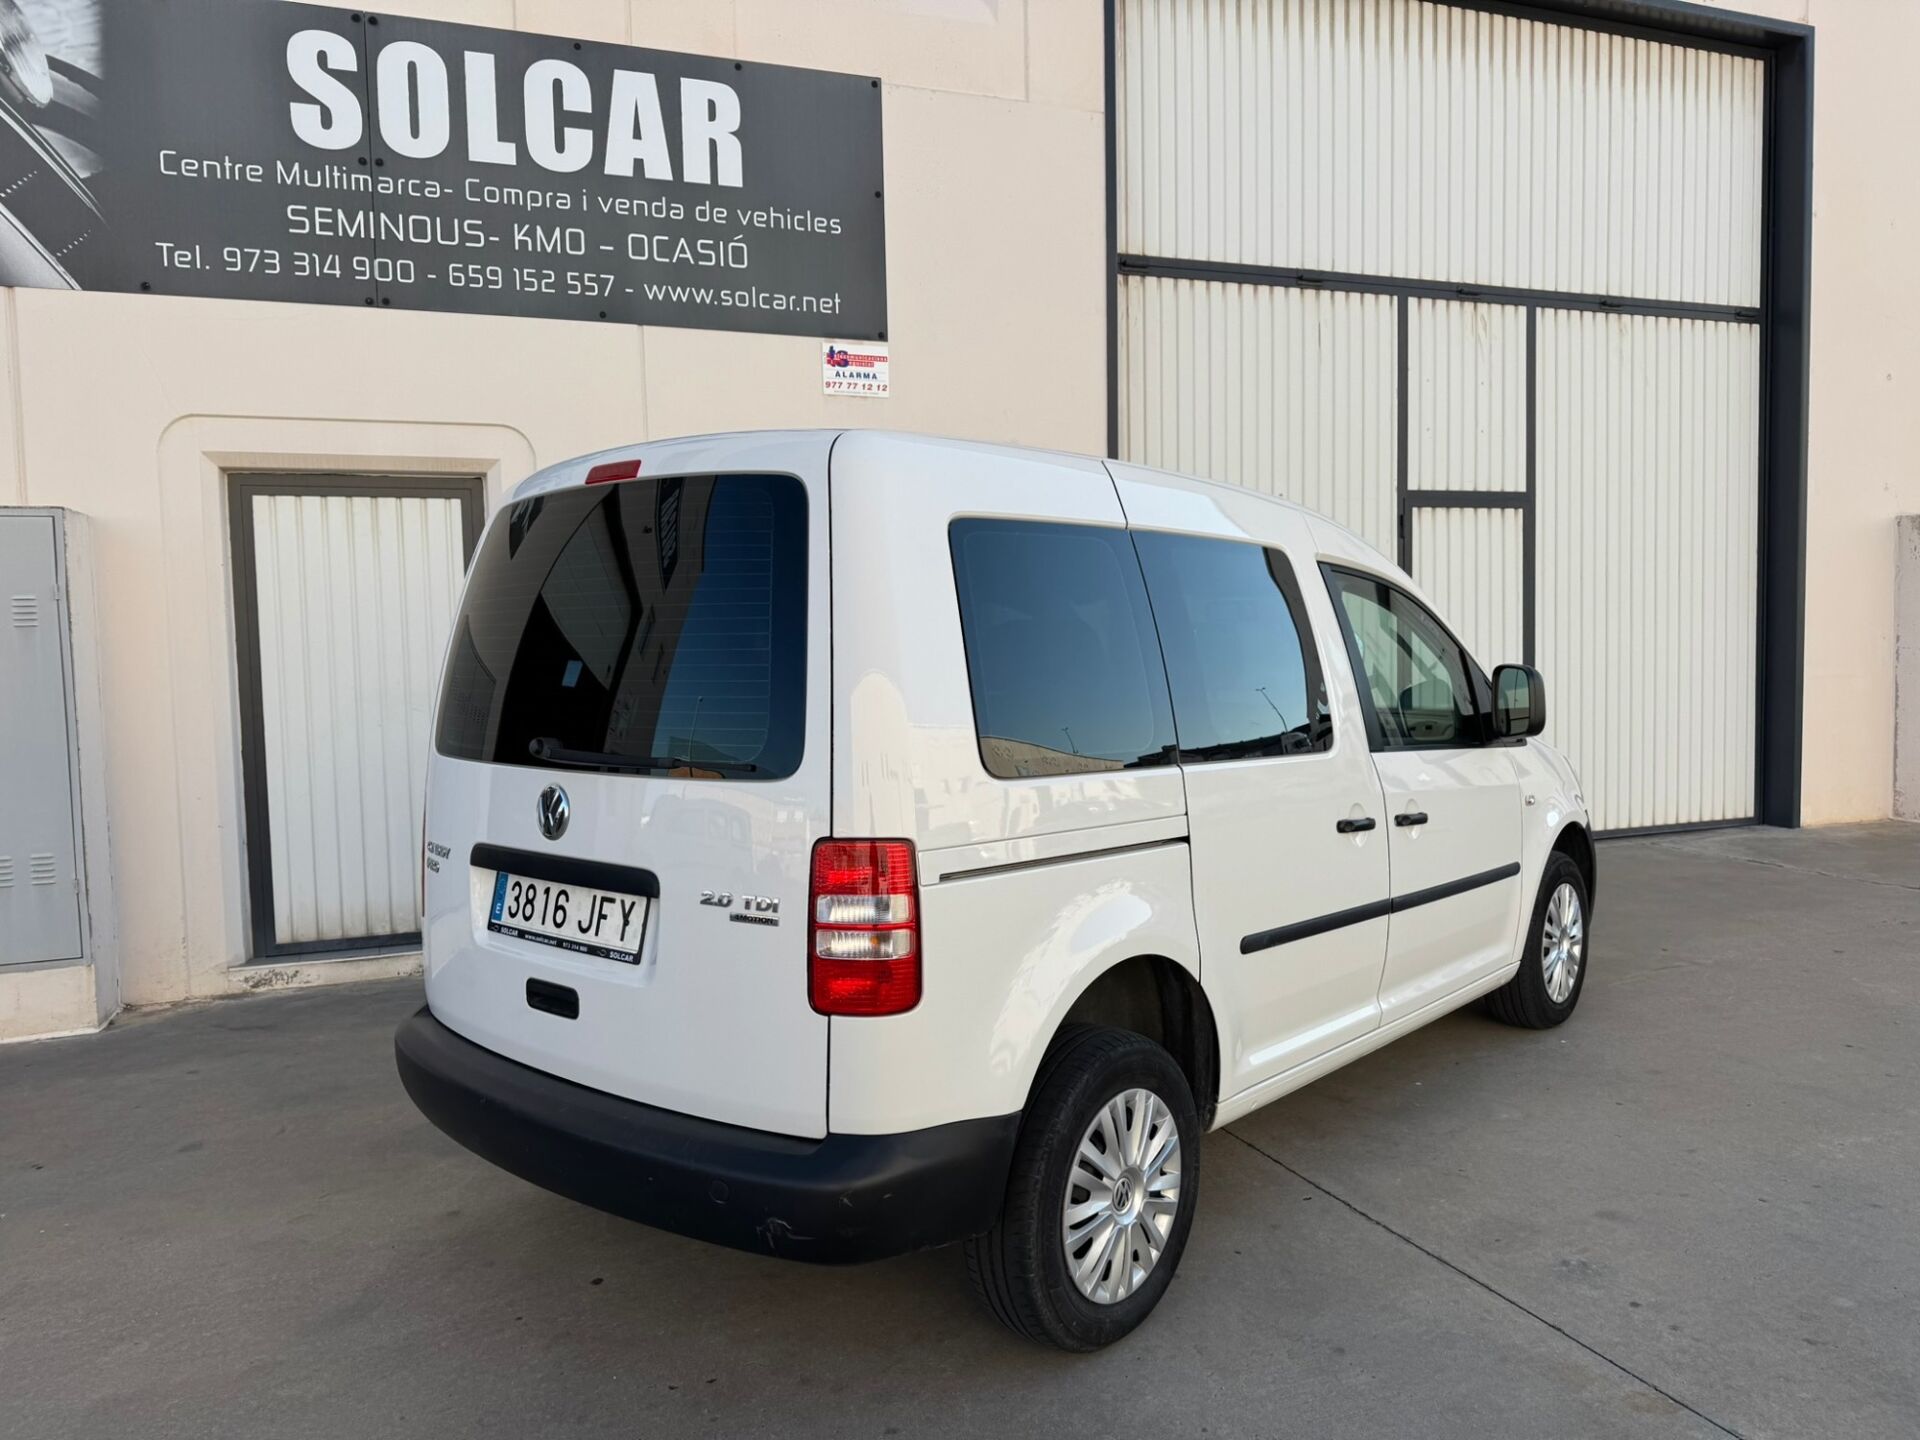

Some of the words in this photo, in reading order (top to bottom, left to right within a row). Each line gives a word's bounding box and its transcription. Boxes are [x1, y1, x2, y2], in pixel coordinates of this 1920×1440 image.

[286, 29, 744, 188] SOLCAR
[159, 149, 264, 183] Centre
[276, 159, 454, 199] Multimarca-
[464, 177, 571, 212] Compra
[582, 189, 588, 212] i
[597, 196, 684, 220] venda
[695, 200, 728, 224] de
[736, 207, 842, 235] vehicles
[286, 204, 500, 248] SEMINOUS-
[627, 232, 748, 269] OCASIÓ
[154, 241, 211, 270] Tel.
[222, 246, 281, 274] 973
[293, 251, 342, 279] 314
[352, 255, 415, 284] 900
[448, 263, 503, 290] 659
[512, 267, 556, 293] 152
[566, 271, 615, 297] 557
[643, 284, 841, 315] www.solcar.net
[825, 381, 843, 389] 977
[835, 370, 878, 380] ALARMA
[508, 880, 570, 929] 3816
[577, 894, 636, 942] JFY
[699, 890, 734, 908] 2.0
[741, 895, 779, 913] TDI
[500, 926, 519, 937] SOLCAR
[609, 950, 634, 963] SOLCAR
